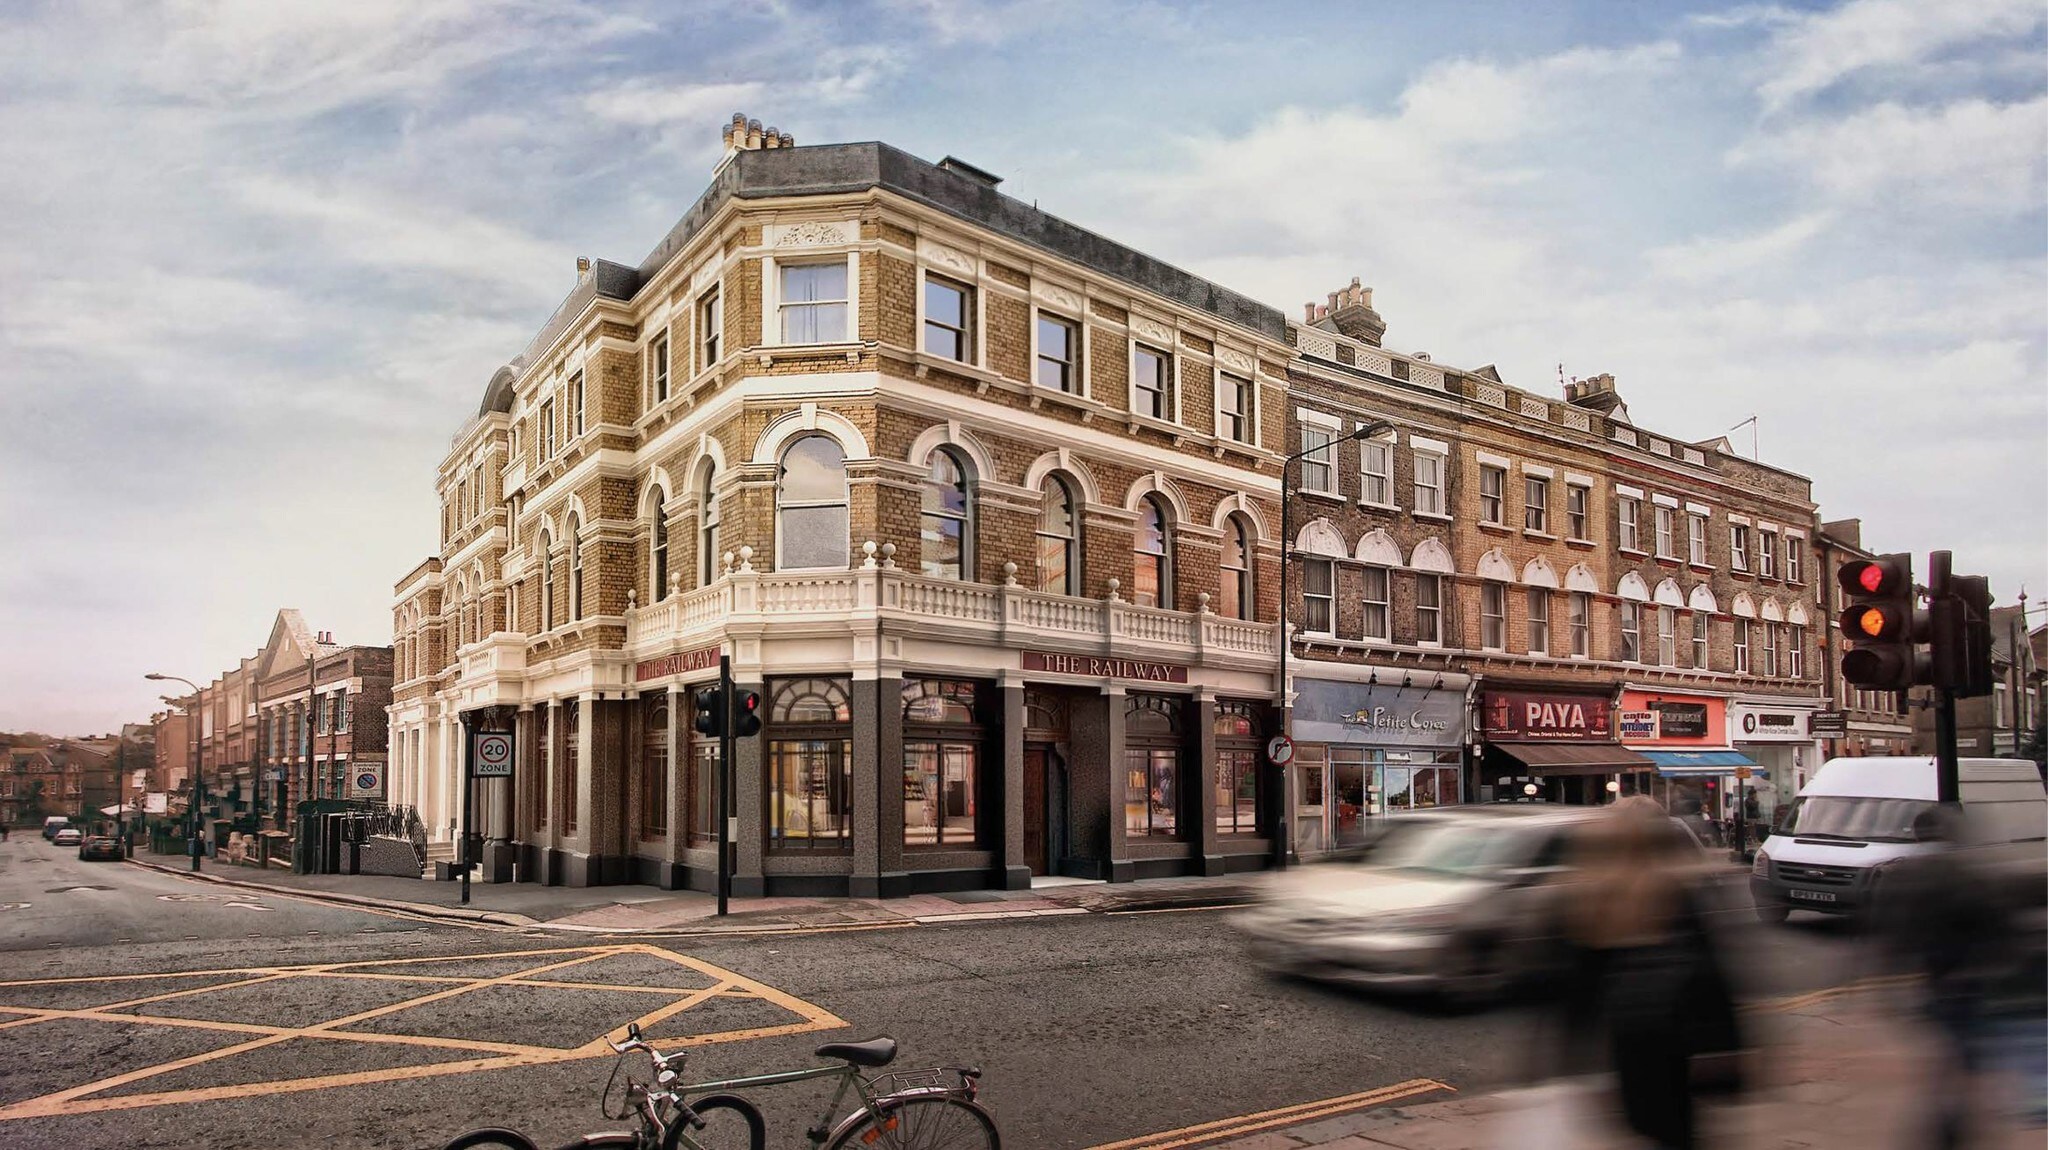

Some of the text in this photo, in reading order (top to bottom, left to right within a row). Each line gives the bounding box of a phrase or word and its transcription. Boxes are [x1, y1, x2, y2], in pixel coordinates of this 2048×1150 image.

[643, 649, 713, 679] THE RAILWAY
[1043, 654, 1173, 681] THE RAILWAY
[1373, 706, 1406, 729] Petite
[1526, 702, 1586, 728] PAYA
[1620, 723, 1655, 731] INTERNET
[484, 744, 505, 755] 20
[480, 764, 508, 772] ZONE
